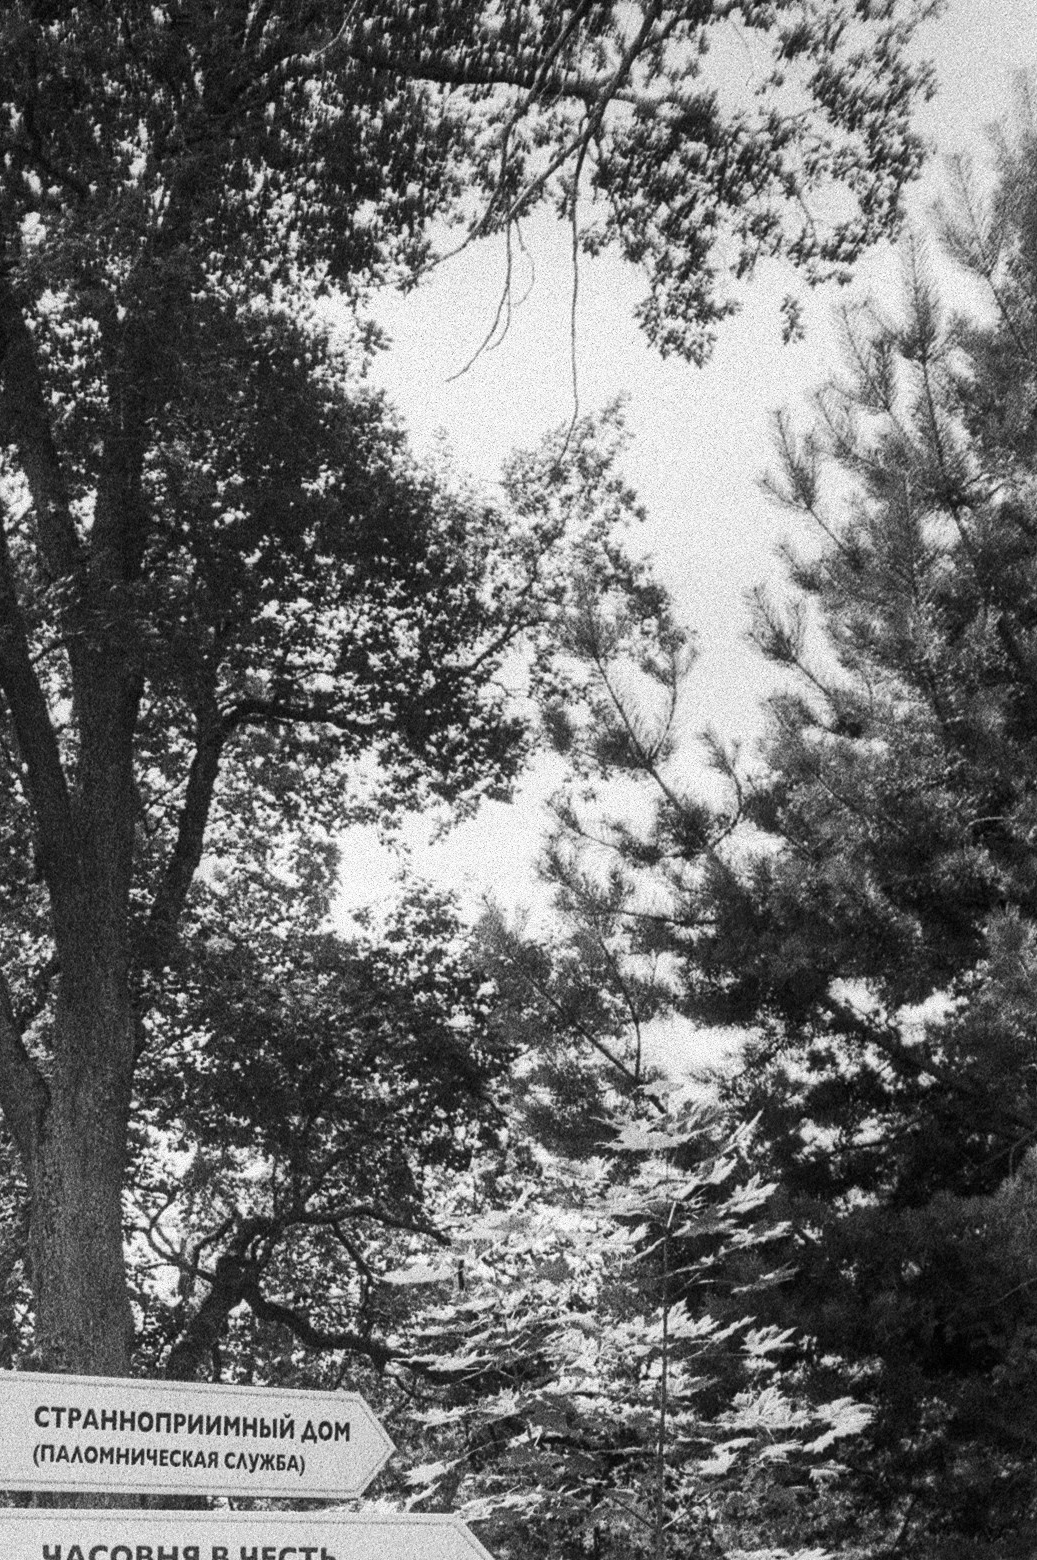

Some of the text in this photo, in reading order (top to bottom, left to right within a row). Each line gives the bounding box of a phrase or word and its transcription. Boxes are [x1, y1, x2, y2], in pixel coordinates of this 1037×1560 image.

[33, 1404, 352, 1444] СТРАННОПРИИМНЫЙ ДОМ
[32, 1443, 306, 1476] (ПАЛОМНИЧЕСКАЯ СЛУЖБА)
